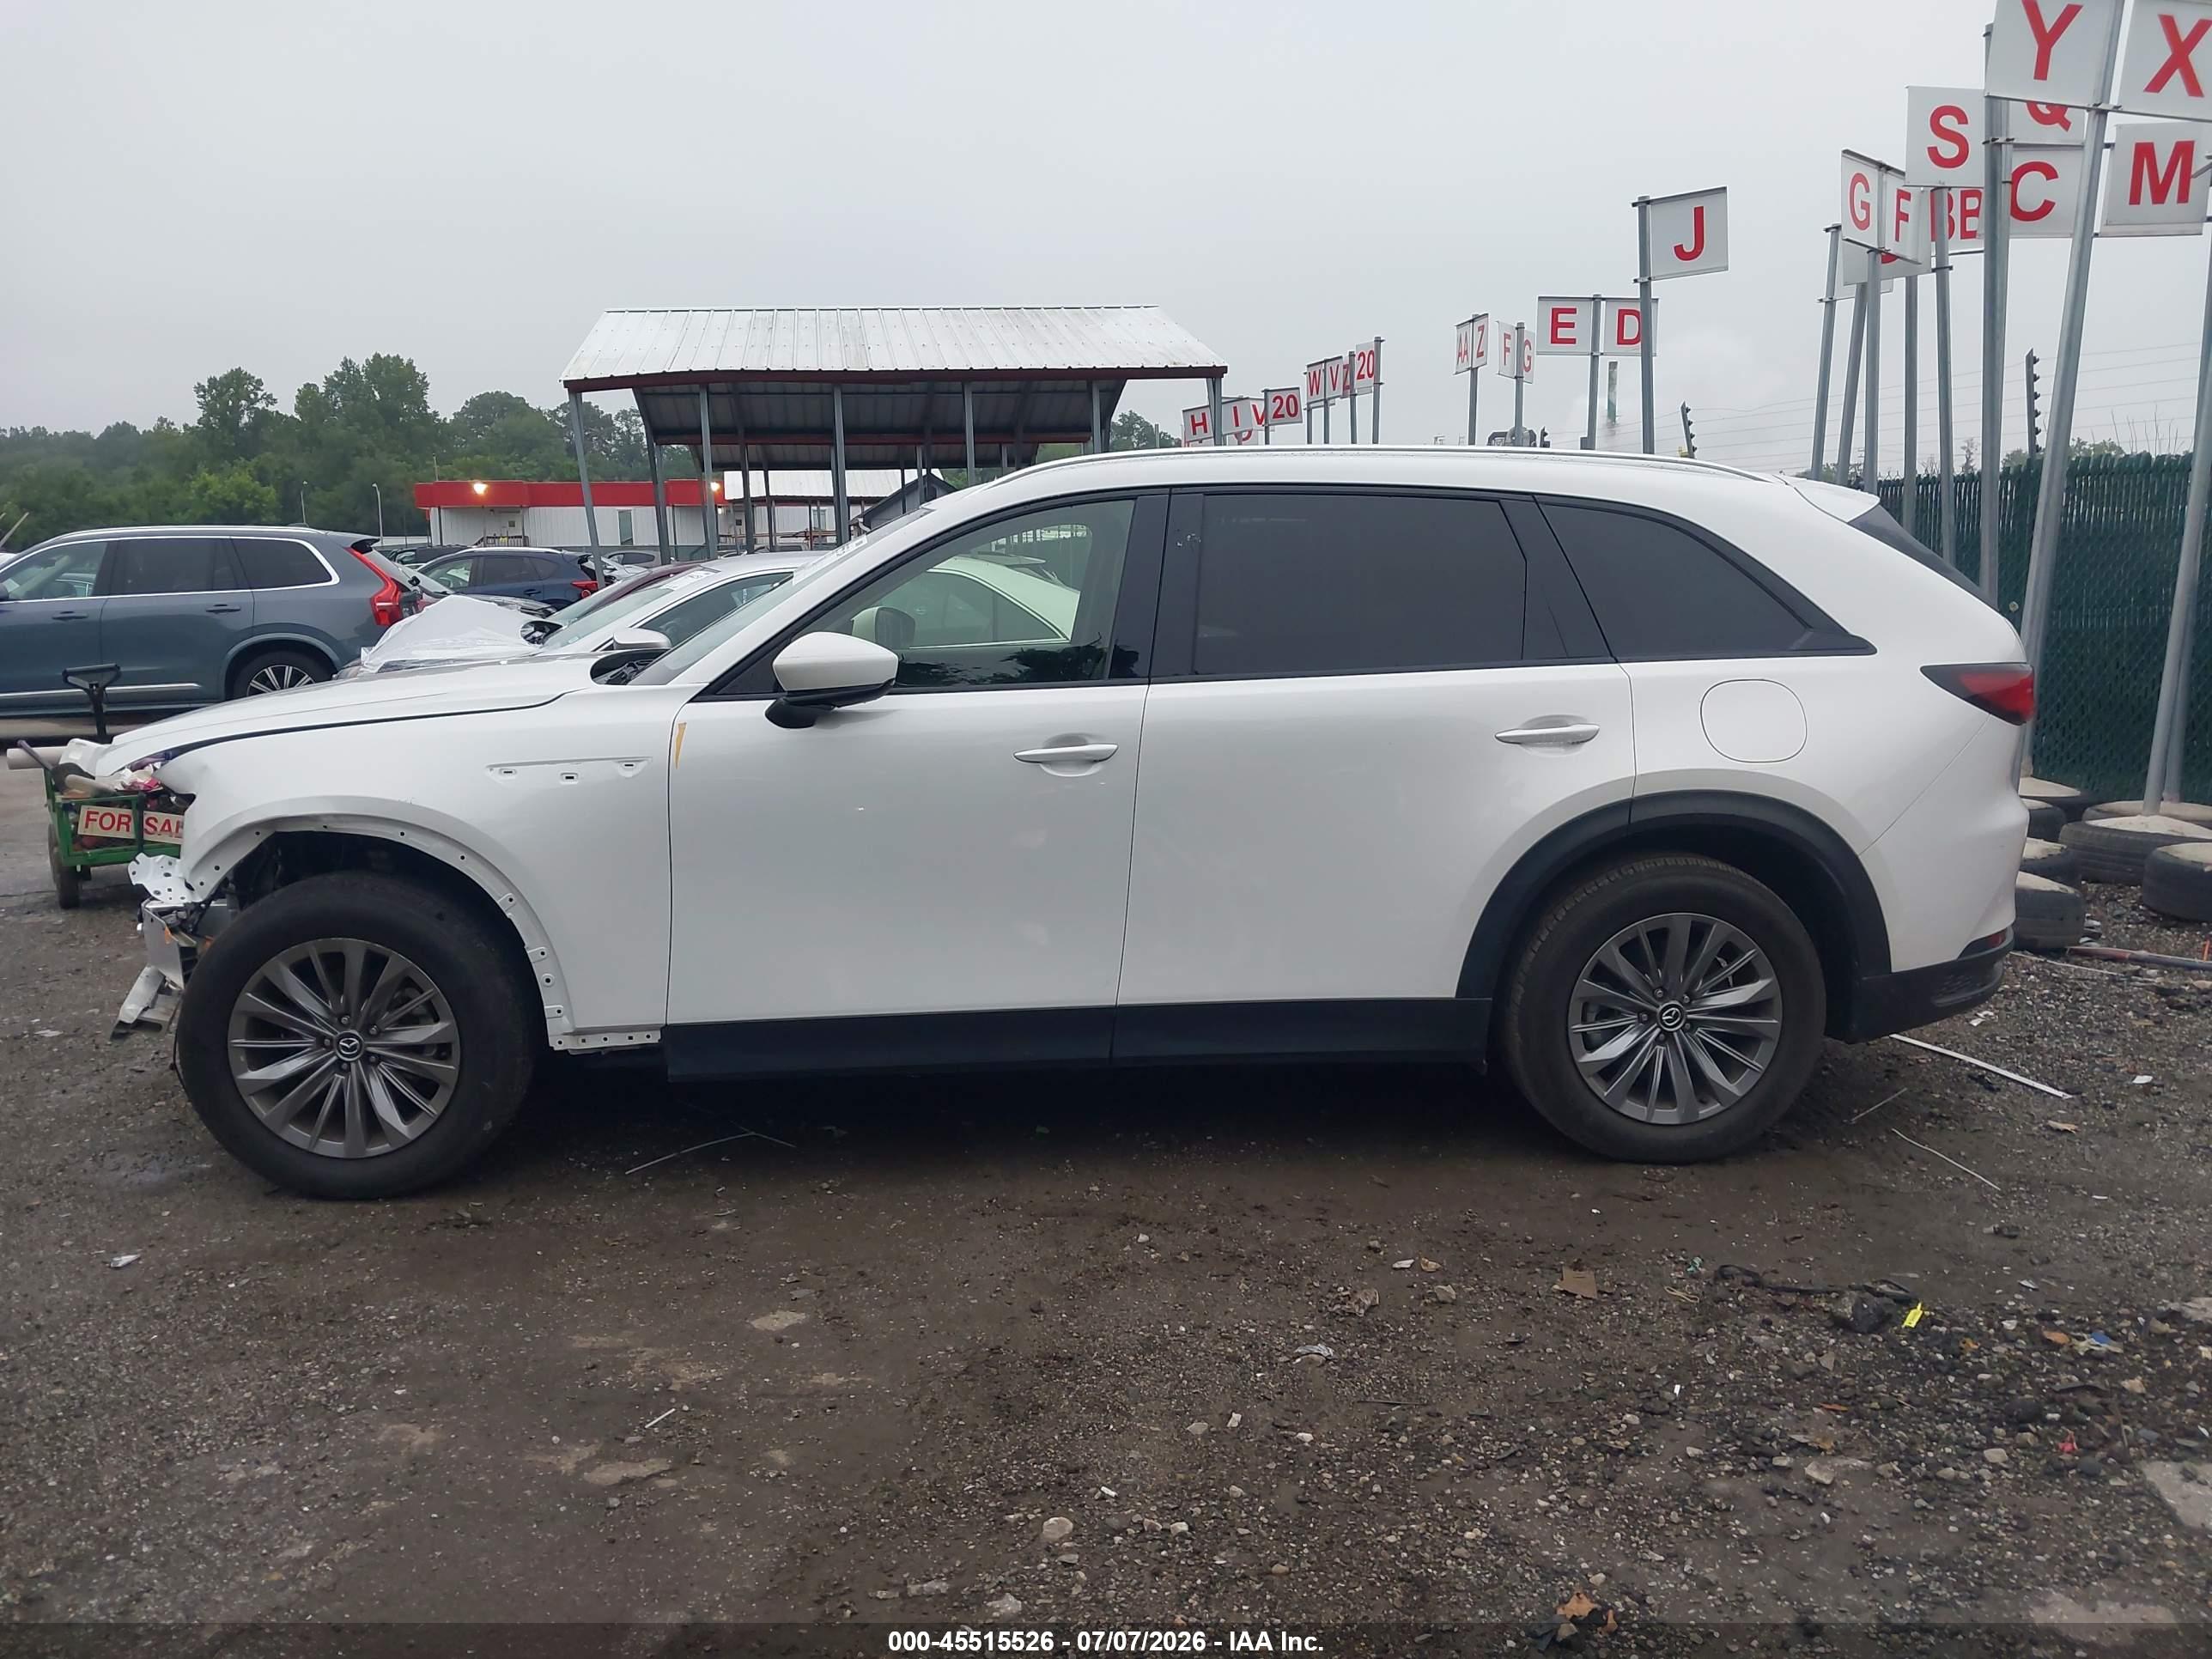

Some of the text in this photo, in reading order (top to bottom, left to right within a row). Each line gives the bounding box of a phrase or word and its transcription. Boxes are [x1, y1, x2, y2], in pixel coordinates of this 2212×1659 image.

[2021, 0, 2083, 81] Y
[2143, 14, 2212, 98] X
[1927, 105, 1970, 168] S
[2129, 140, 2195, 205] M
[1849, 172, 1871, 231] G
[2010, 161, 2059, 222] C
[1894, 188, 1911, 242] F
[1673, 205, 1705, 261] J
[1476, 325, 1486, 358] Z
[1550, 307, 1577, 344] E
[1616, 309, 1641, 345] D
[1356, 349, 1375, 380] 20
[1456, 331, 1469, 366] AA
[1504, 332, 1511, 366] F
[1523, 339, 1532, 372] G
[1308, 369, 1322, 397] W
[1329, 363, 1340, 392] V
[1190, 412, 1208, 436] H
[1232, 405, 1240, 428] I
[1272, 394, 1298, 419] 20
[84, 810, 184, 838] FOR SAL
